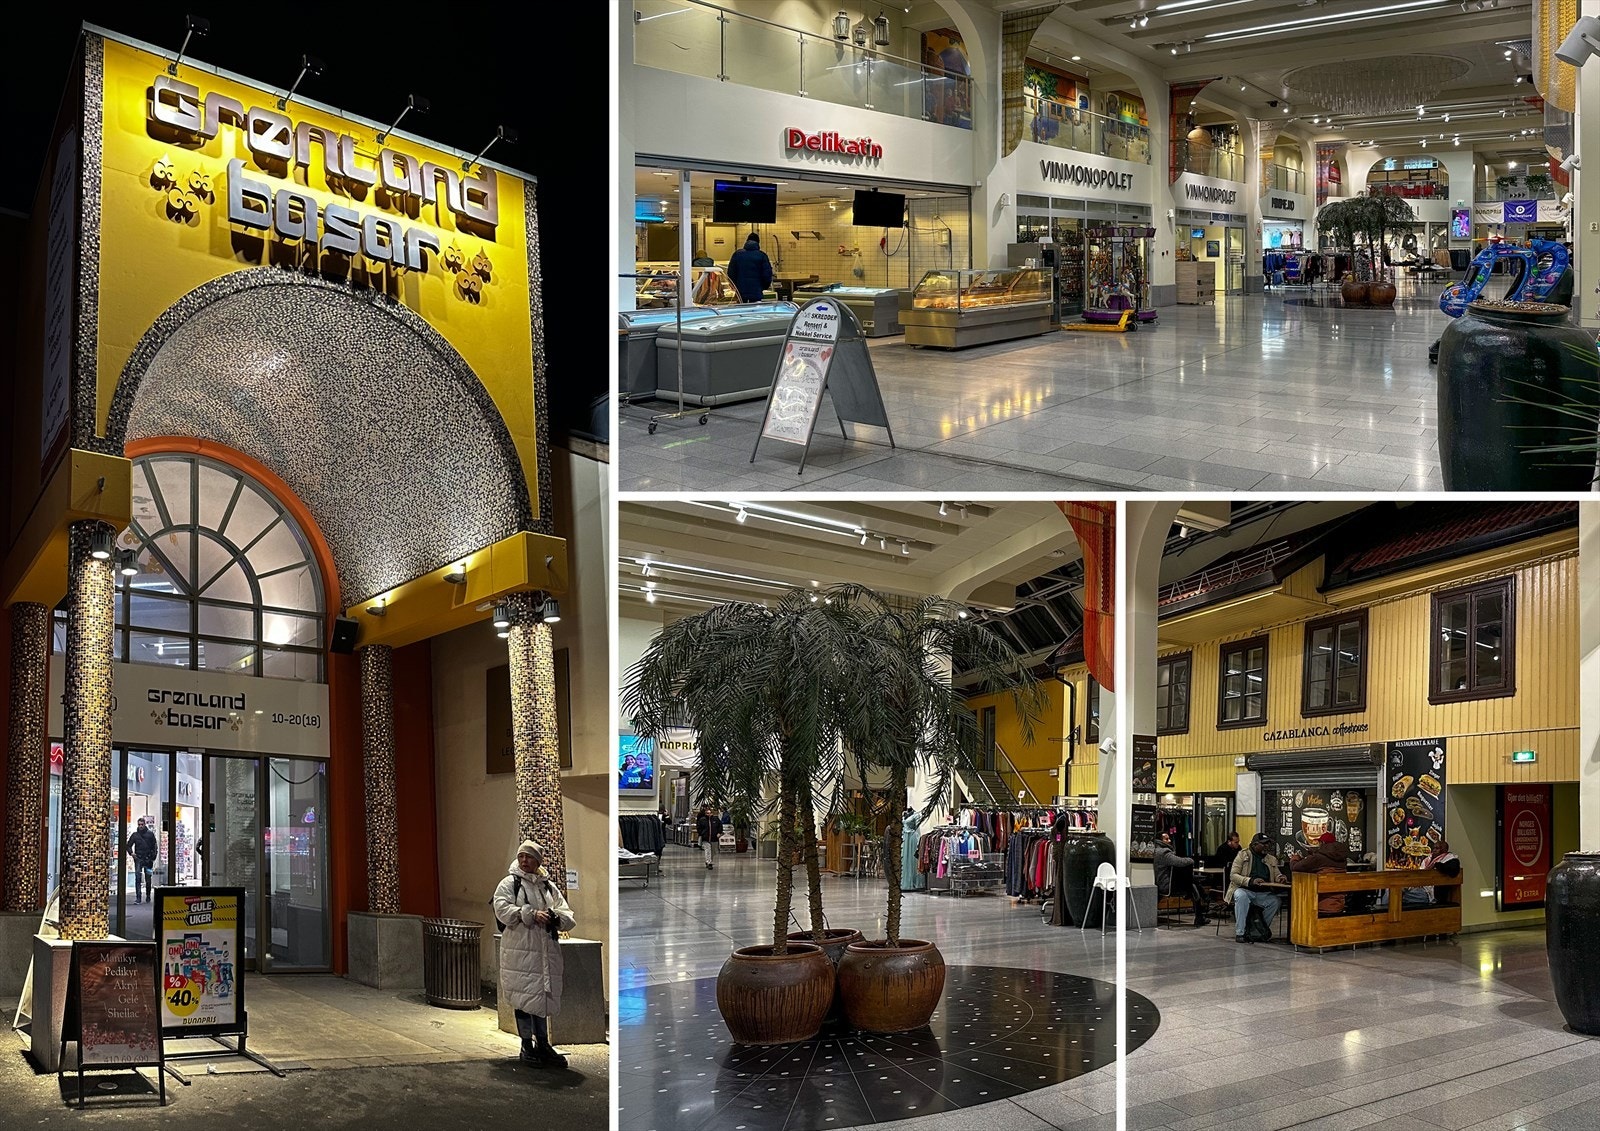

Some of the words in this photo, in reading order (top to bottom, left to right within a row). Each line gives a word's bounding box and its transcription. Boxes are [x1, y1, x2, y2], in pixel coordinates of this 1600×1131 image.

[148, 74, 499, 238] Grønland
[1040, 159, 1133, 190] VINMONOPOLET
[1185, 183, 1236, 205] VINMONOPOLET
[227, 158, 441, 273] basar
[813, 331, 833, 340] Service
[147, 688, 246, 711] Grønland
[167, 707, 227, 730] basar
[271, 713, 321, 729] 10-20(18)
[1263, 726, 1330, 741] CAZABLANCA
[1332, 721, 1369, 737] coffeehouse
[1523, 890, 1539, 898] EXTRA
[190, 901, 212, 912] GULE
[189, 913, 212, 925] UKER
[99, 953, 137, 964] Manikyr
[104, 966, 138, 977] Pedikyr
[113, 979, 138, 991] Akryl
[118, 992, 139, 1004] Gelé
[107, 1006, 140, 1018] Shellac
